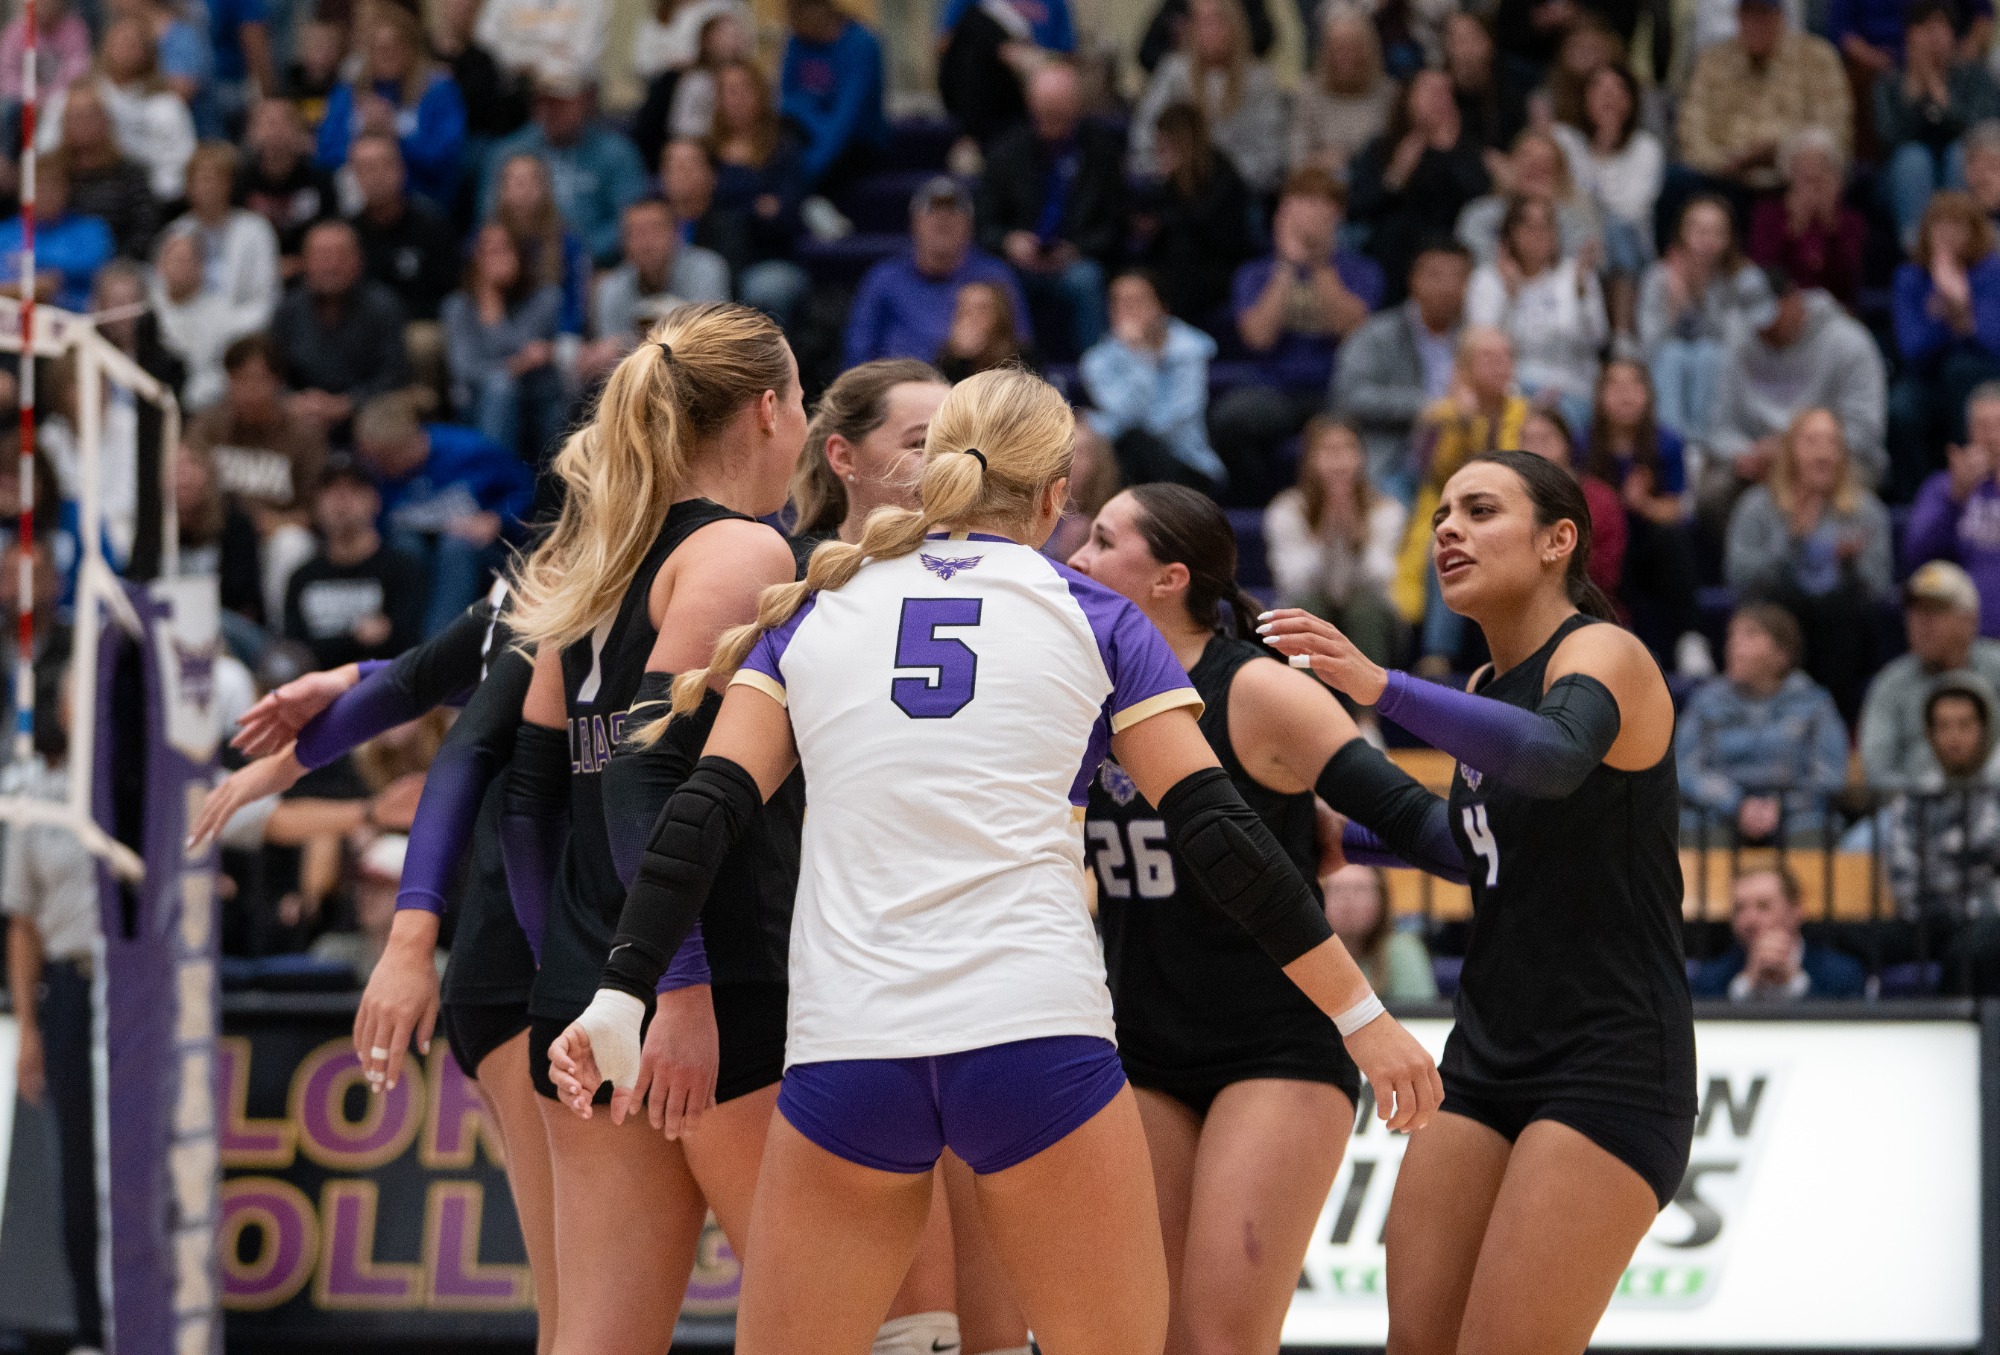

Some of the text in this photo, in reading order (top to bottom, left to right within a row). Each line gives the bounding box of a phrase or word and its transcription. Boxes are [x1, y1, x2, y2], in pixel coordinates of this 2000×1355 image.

[890, 597, 984, 720] 5
[1086, 819, 1176, 898] 26
[1462, 804, 1499, 888] 4
